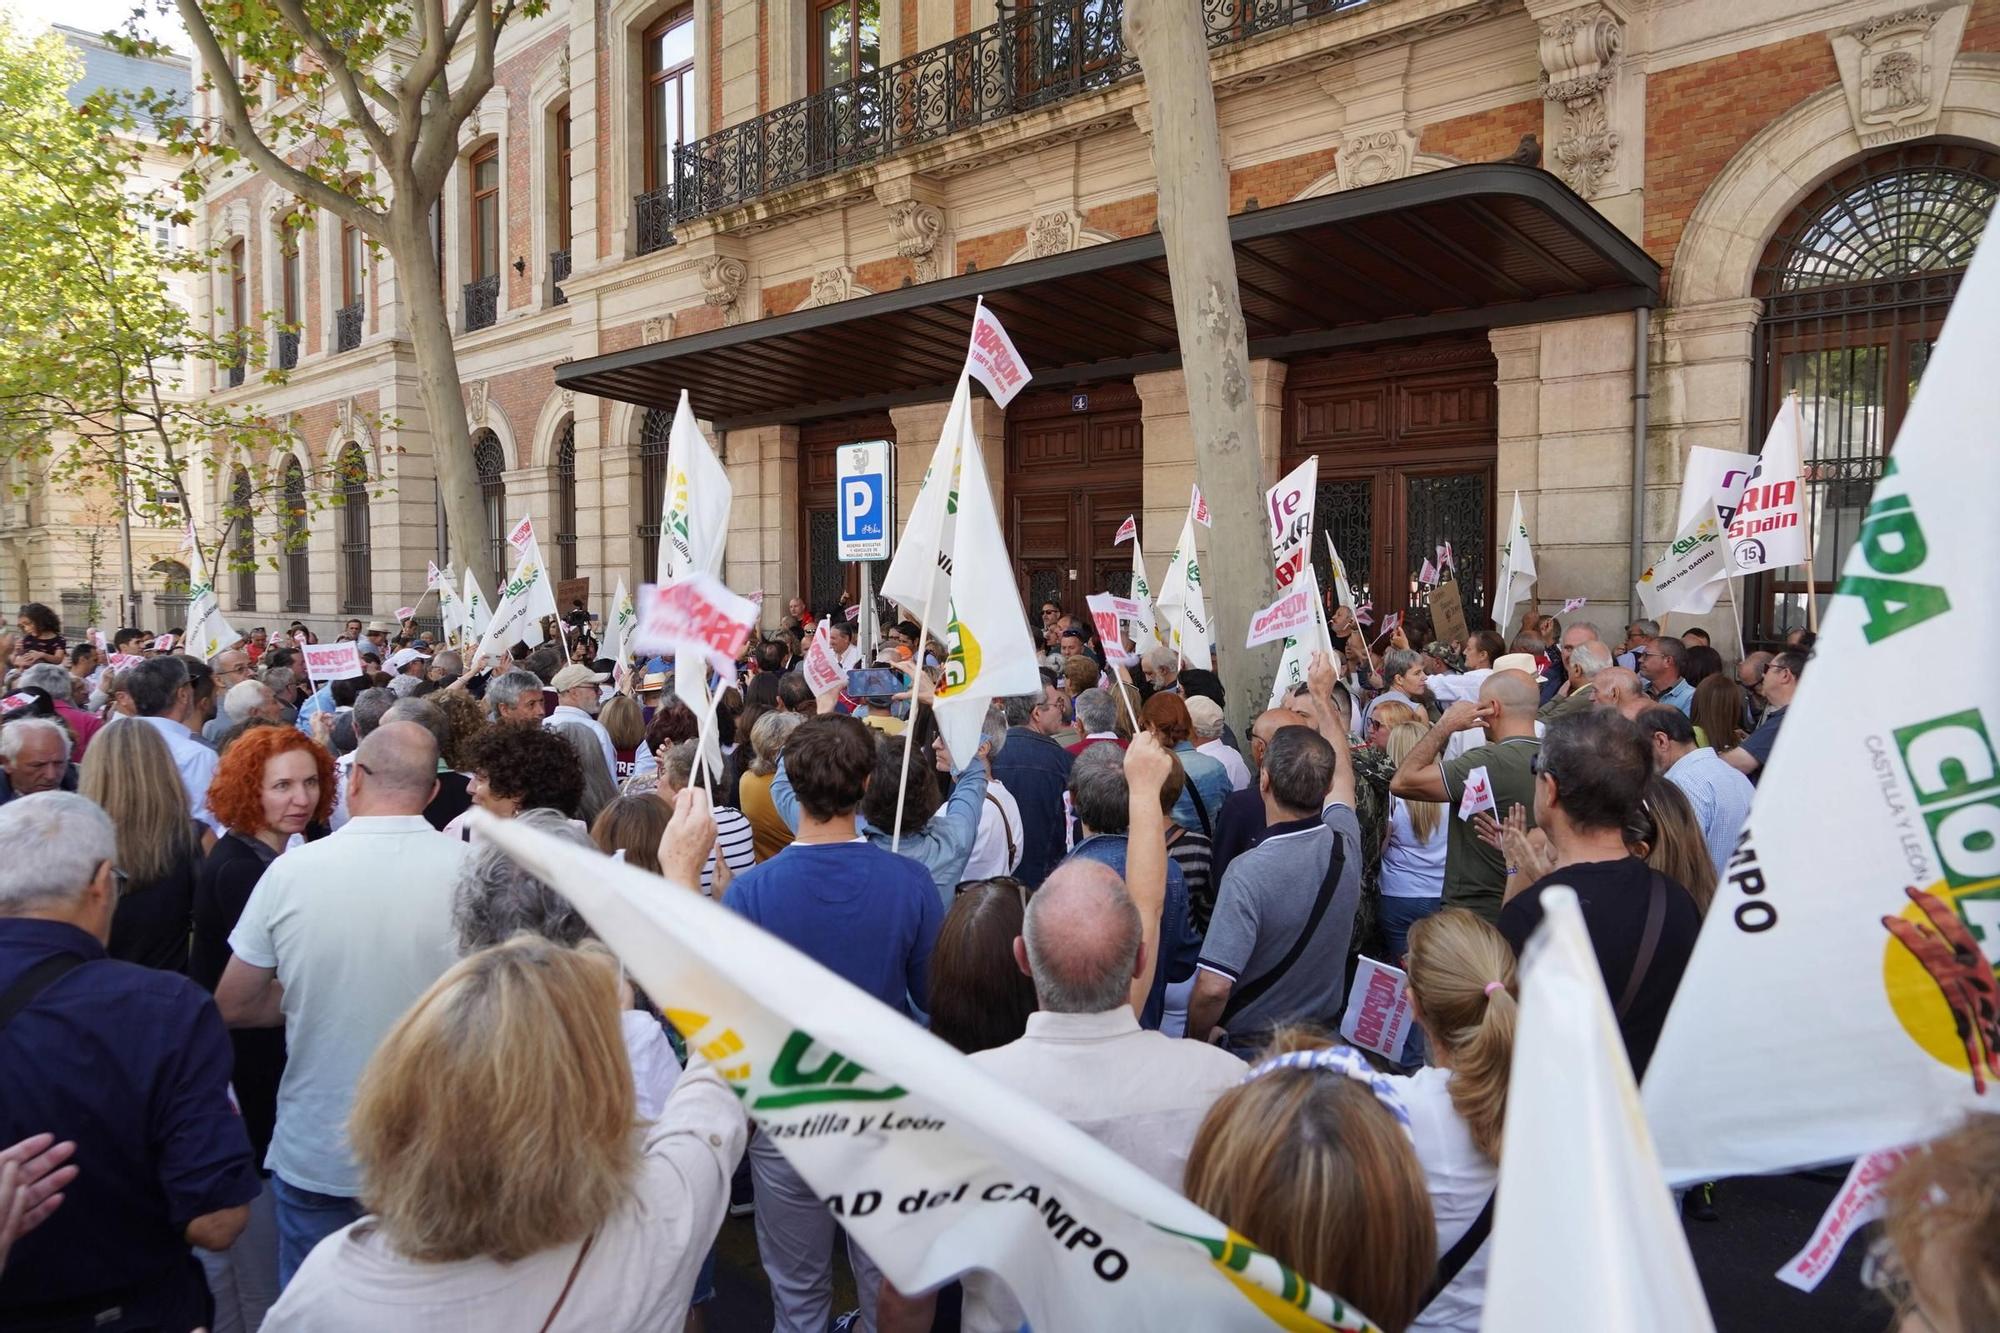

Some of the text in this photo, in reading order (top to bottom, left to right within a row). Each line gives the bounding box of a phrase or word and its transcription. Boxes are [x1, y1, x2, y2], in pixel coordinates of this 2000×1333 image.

[1866, 122, 1929, 146] MADRID
[1074, 397, 1085, 409] 4
[845, 481, 873, 535] P
[1727, 512, 1798, 539] Spain
[1742, 546, 1757, 560] 15
[1186, 610, 1205, 634] CAMPO
[1864, 735, 1931, 882] CASTILLA Y LEÓN
[852, 1116, 876, 1136] y
[879, 1111, 945, 1132] León
[897, 1182, 970, 1214] del
[981, 1182, 1129, 1283] CAMPO
